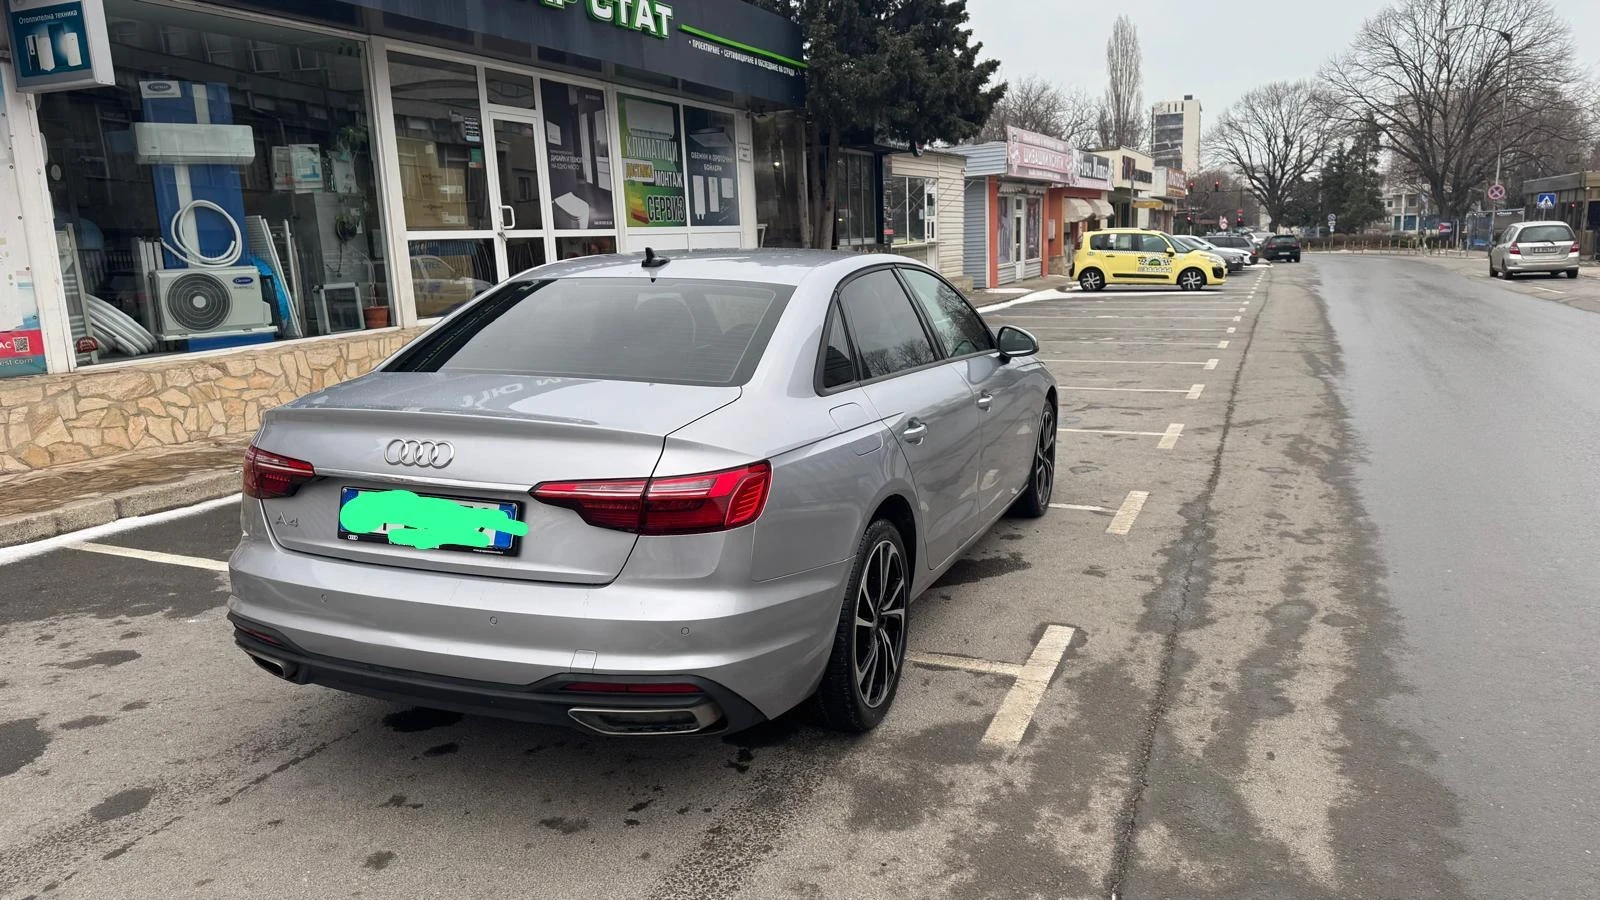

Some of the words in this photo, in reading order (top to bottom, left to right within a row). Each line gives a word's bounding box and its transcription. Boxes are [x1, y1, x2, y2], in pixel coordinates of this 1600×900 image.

[55, 9, 78, 19] техника
[588, 0, 672, 38] СТАТ
[626, 136, 678, 164] КЛИМАТИЦИ
[655, 170, 683, 187] МОНТАЖ
[647, 194, 685, 222] СЕРВИЗ
[276, 511, 299, 528] A4
